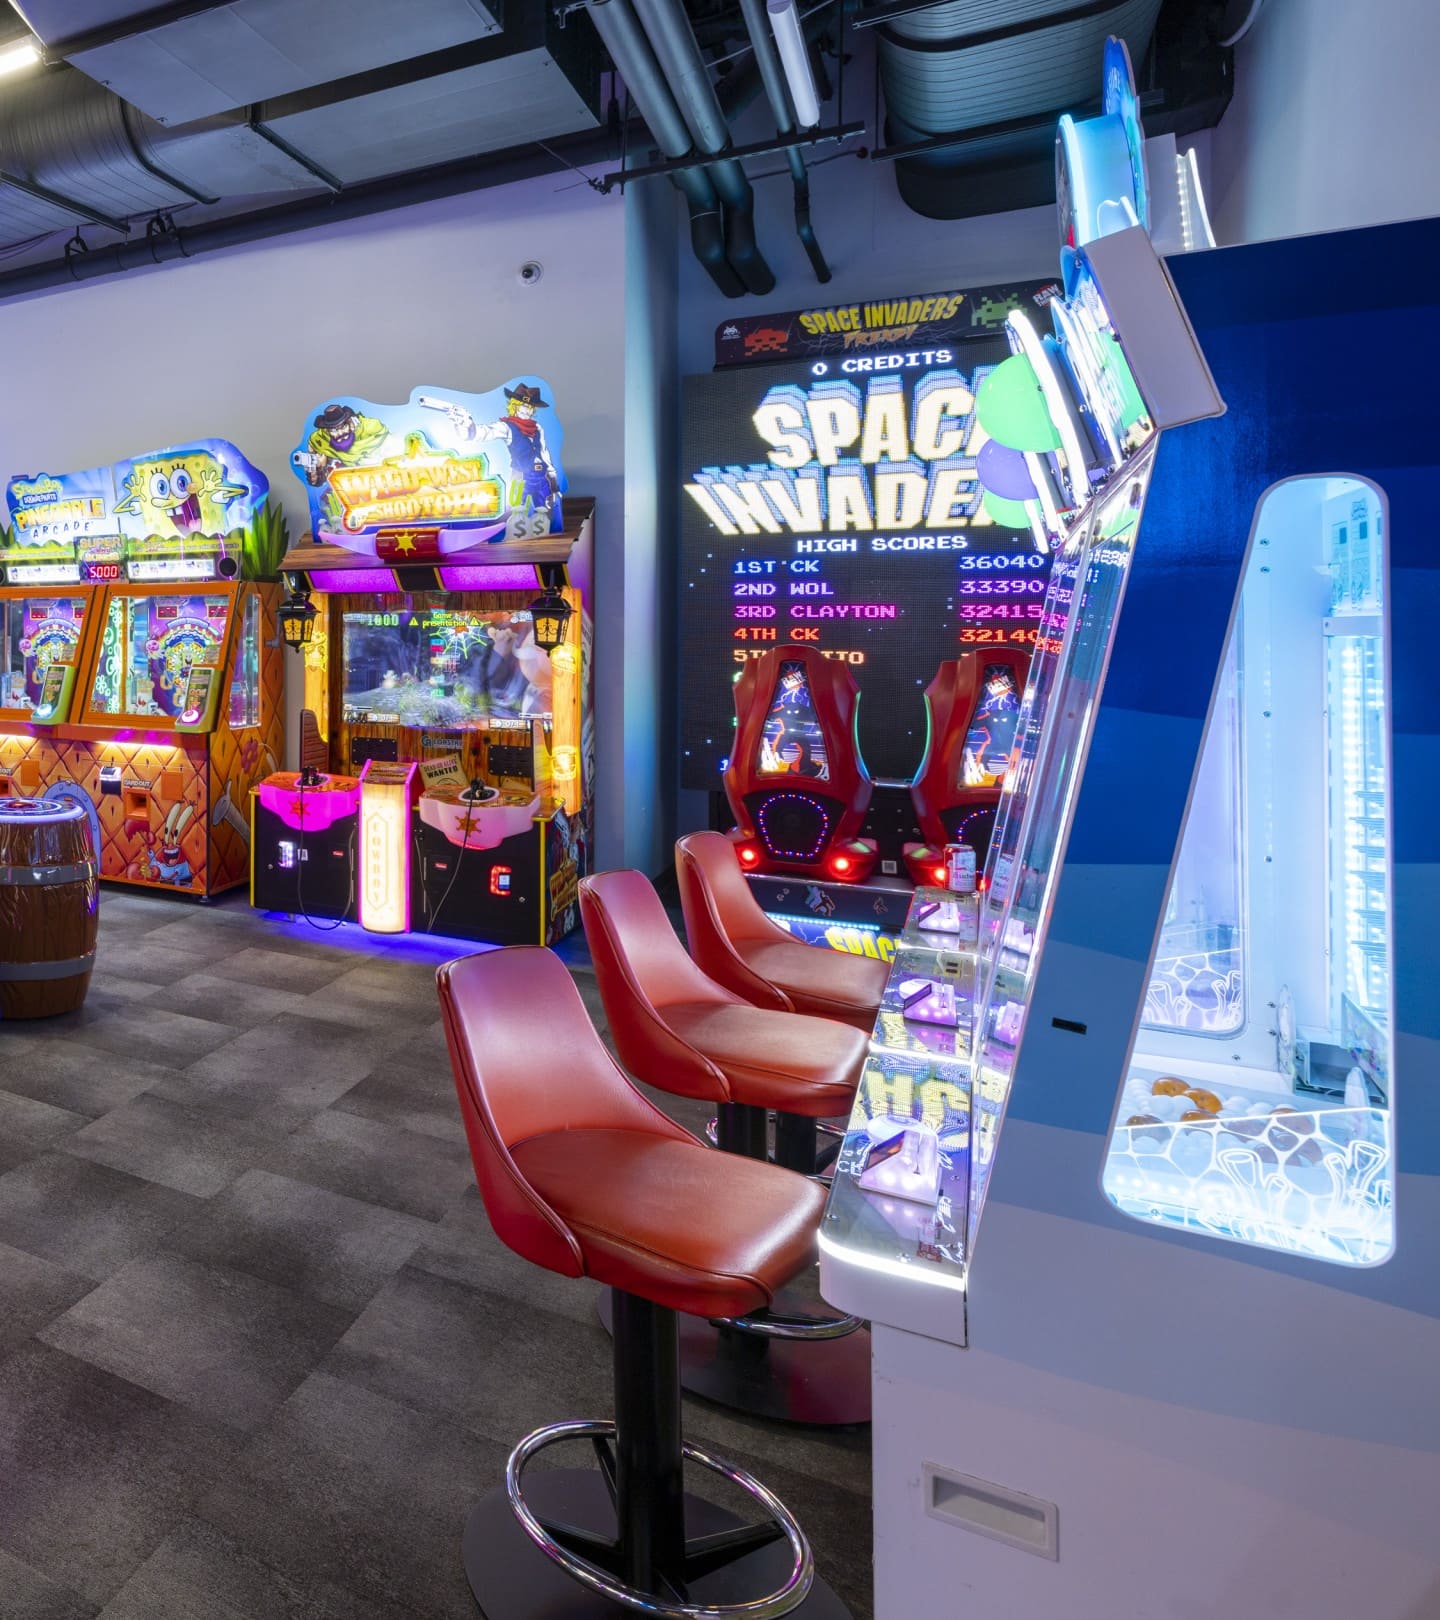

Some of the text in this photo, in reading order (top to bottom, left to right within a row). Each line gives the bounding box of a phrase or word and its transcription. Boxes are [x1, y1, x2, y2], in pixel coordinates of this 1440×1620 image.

[799, 294, 965, 335] SPACE INVADERS
[843, 323, 919, 349] FRENZY
[812, 349, 954, 376] 0 CREDITS
[340, 467, 420, 503] WILD
[15, 497, 106, 533] PINEAPPLE
[32, 521, 90, 538] ARCADE
[796, 535, 969, 553] HIGH SCORES
[90, 566, 119, 579] 5000
[733, 560, 777, 575] 1ST
[789, 559, 820, 574] CK
[959, 554, 1045, 570] 36040
[733, 579, 1045, 596] 2ND WOL 33390
[733, 604, 1044, 619] 3RD CLAYTON 32415
[733, 627, 777, 642] 4TH
[789, 627, 820, 641] CK
[426, 765, 459, 779] WANTED
